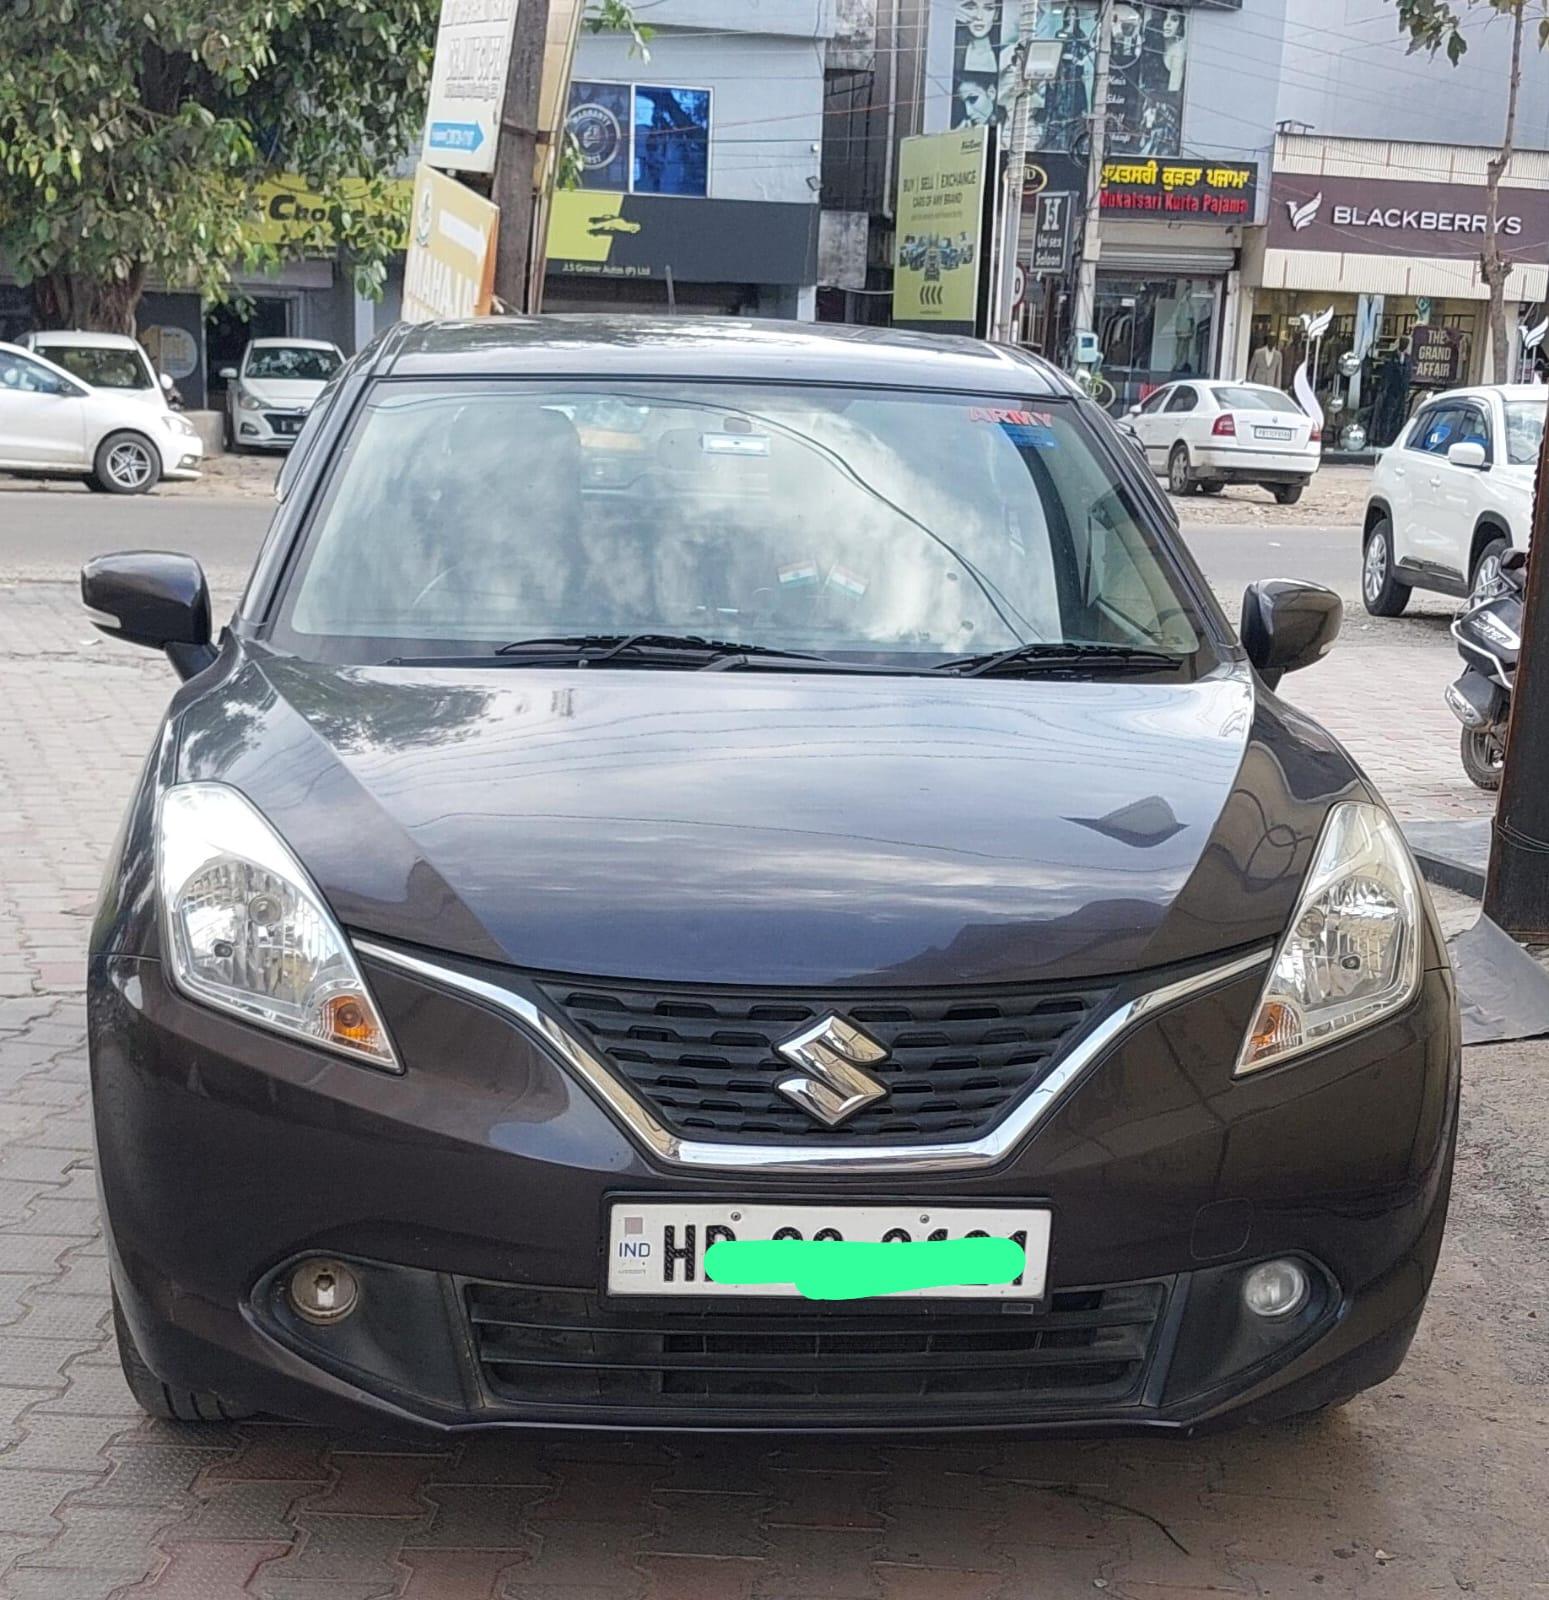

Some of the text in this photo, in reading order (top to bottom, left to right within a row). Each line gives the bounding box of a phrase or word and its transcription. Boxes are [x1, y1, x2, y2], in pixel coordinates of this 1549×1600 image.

[1164, 193, 1199, 213] Kurta
[1202, 194, 1248, 216] Pajama
[1333, 205, 1523, 235] BLACKBERRYS
[1427, 329, 1448, 345] THE
[1418, 345, 1452, 361] GRAND
[1415, 361, 1450, 377] AFFAIR
[968, 407, 1053, 429] ARMY
[618, 1242, 651, 1258] IND
